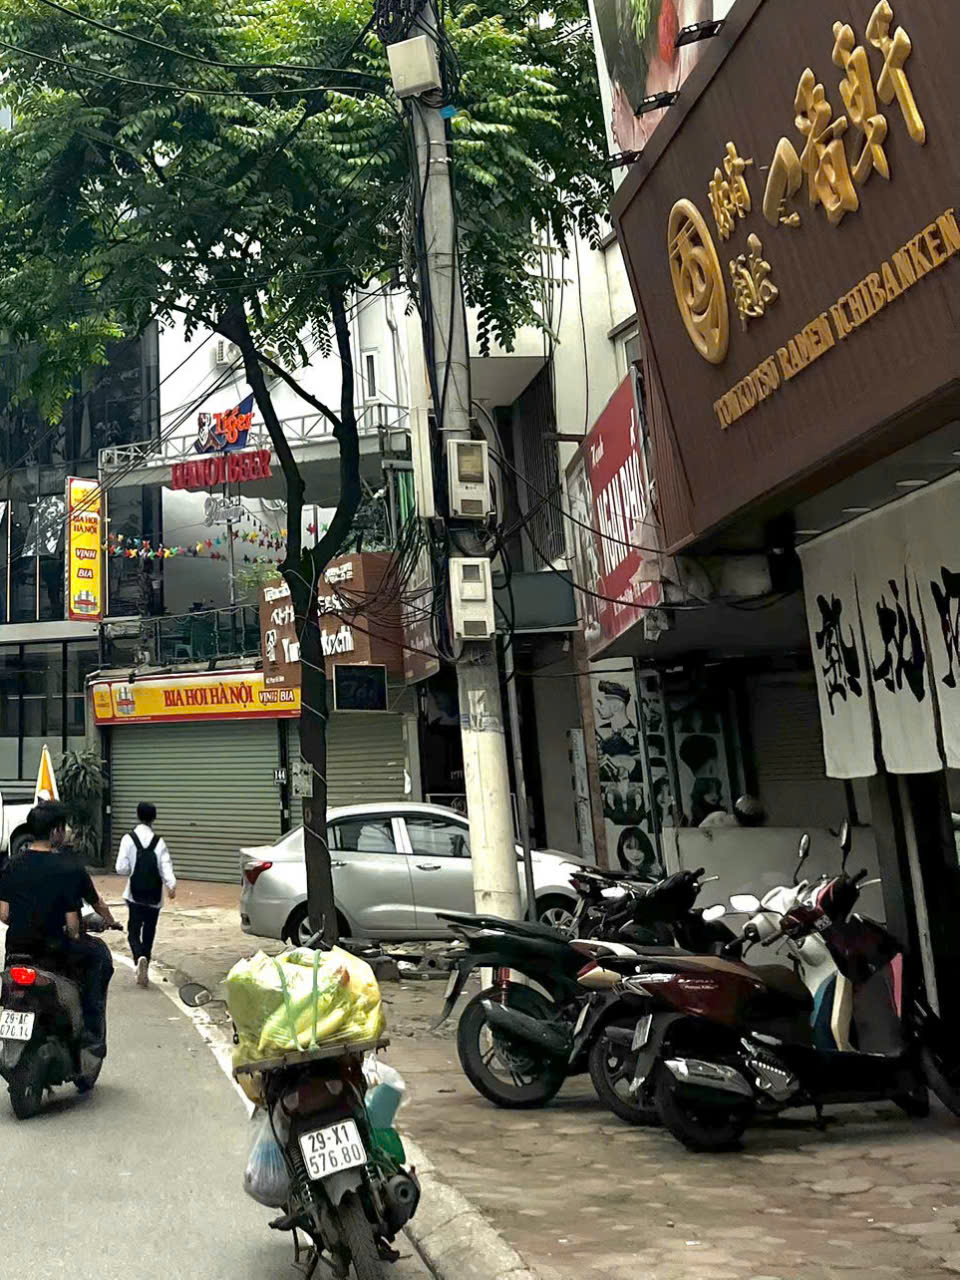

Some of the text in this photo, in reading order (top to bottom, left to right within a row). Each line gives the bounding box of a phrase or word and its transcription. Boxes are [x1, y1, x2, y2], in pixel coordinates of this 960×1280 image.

[776, 312, 836, 380] RAMEN
[830, 208, 960, 340] ICHIBANKEN
[213, 406, 255, 443] Tiger
[171, 449, 272, 490] HANOI BEER
[79, 568, 93, 577] BIA
[163, 688, 184, 707] BIA
[210, 682, 229, 705] HÀ
[229, 682, 253, 708] NỘI
[281, 690, 294, 702] BIA
[307, 1125, 350, 1153] 29-X1
[309, 1143, 361, 1174] 576.80
